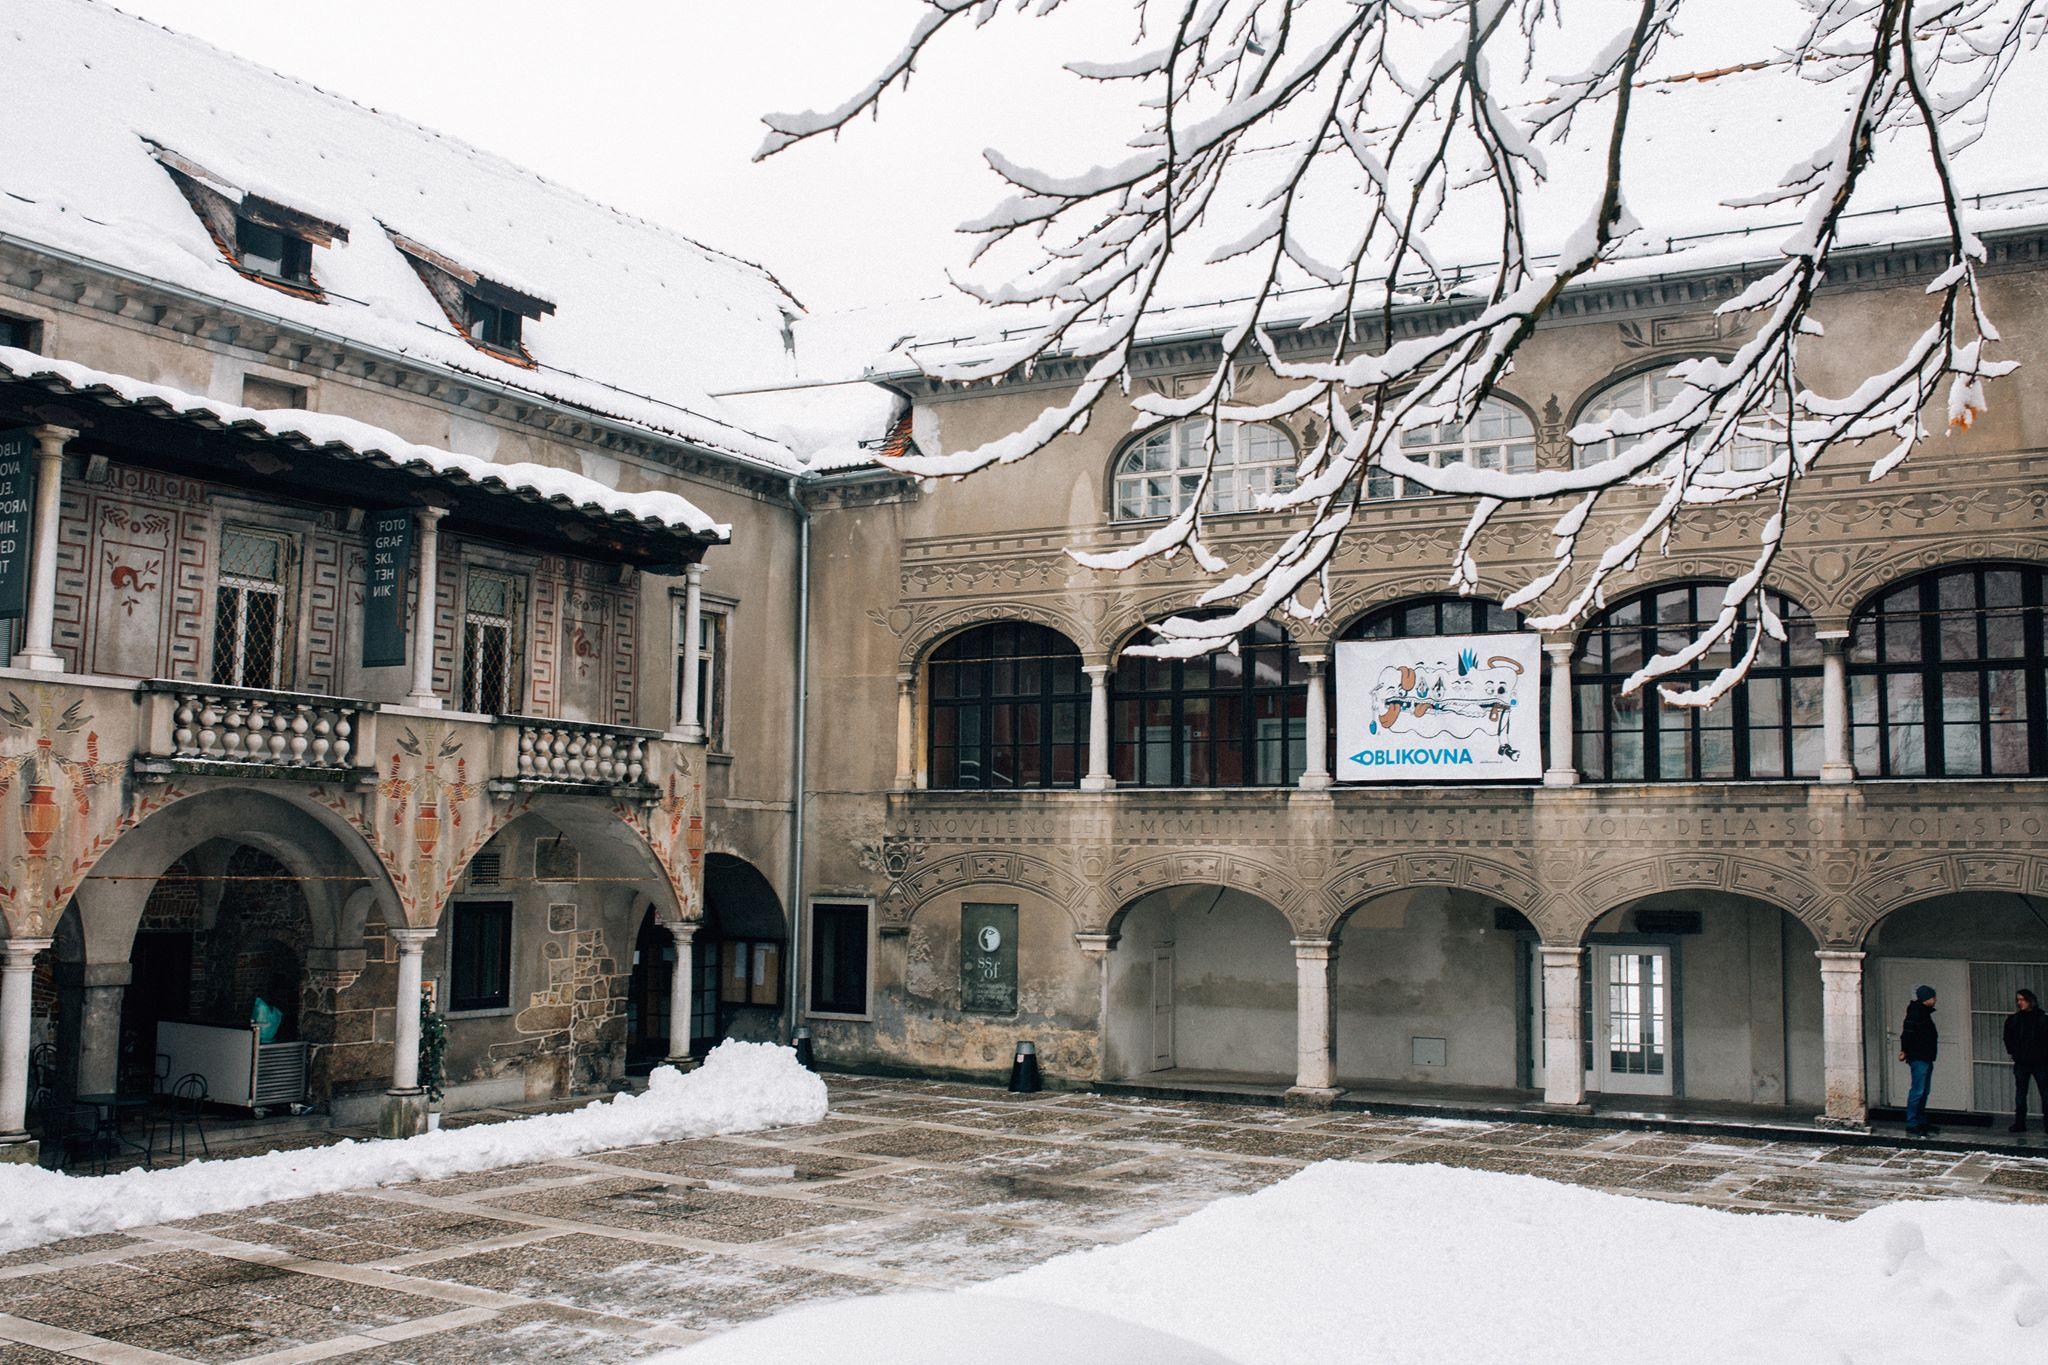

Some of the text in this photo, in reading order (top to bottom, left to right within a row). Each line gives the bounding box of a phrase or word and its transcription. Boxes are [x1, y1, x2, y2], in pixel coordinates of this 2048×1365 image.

[375, 535, 403, 549] GRAF
[1351, 749, 1473, 766] OBLIKOVNA
[1071, 819, 1122, 834] LETA
[1445, 819, 1465, 835] SI
[1501, 819, 1529, 835] LE
[1678, 818, 1760, 836] DELA
[1786, 818, 1824, 835] SO
[1974, 817, 2041, 836] SPO
